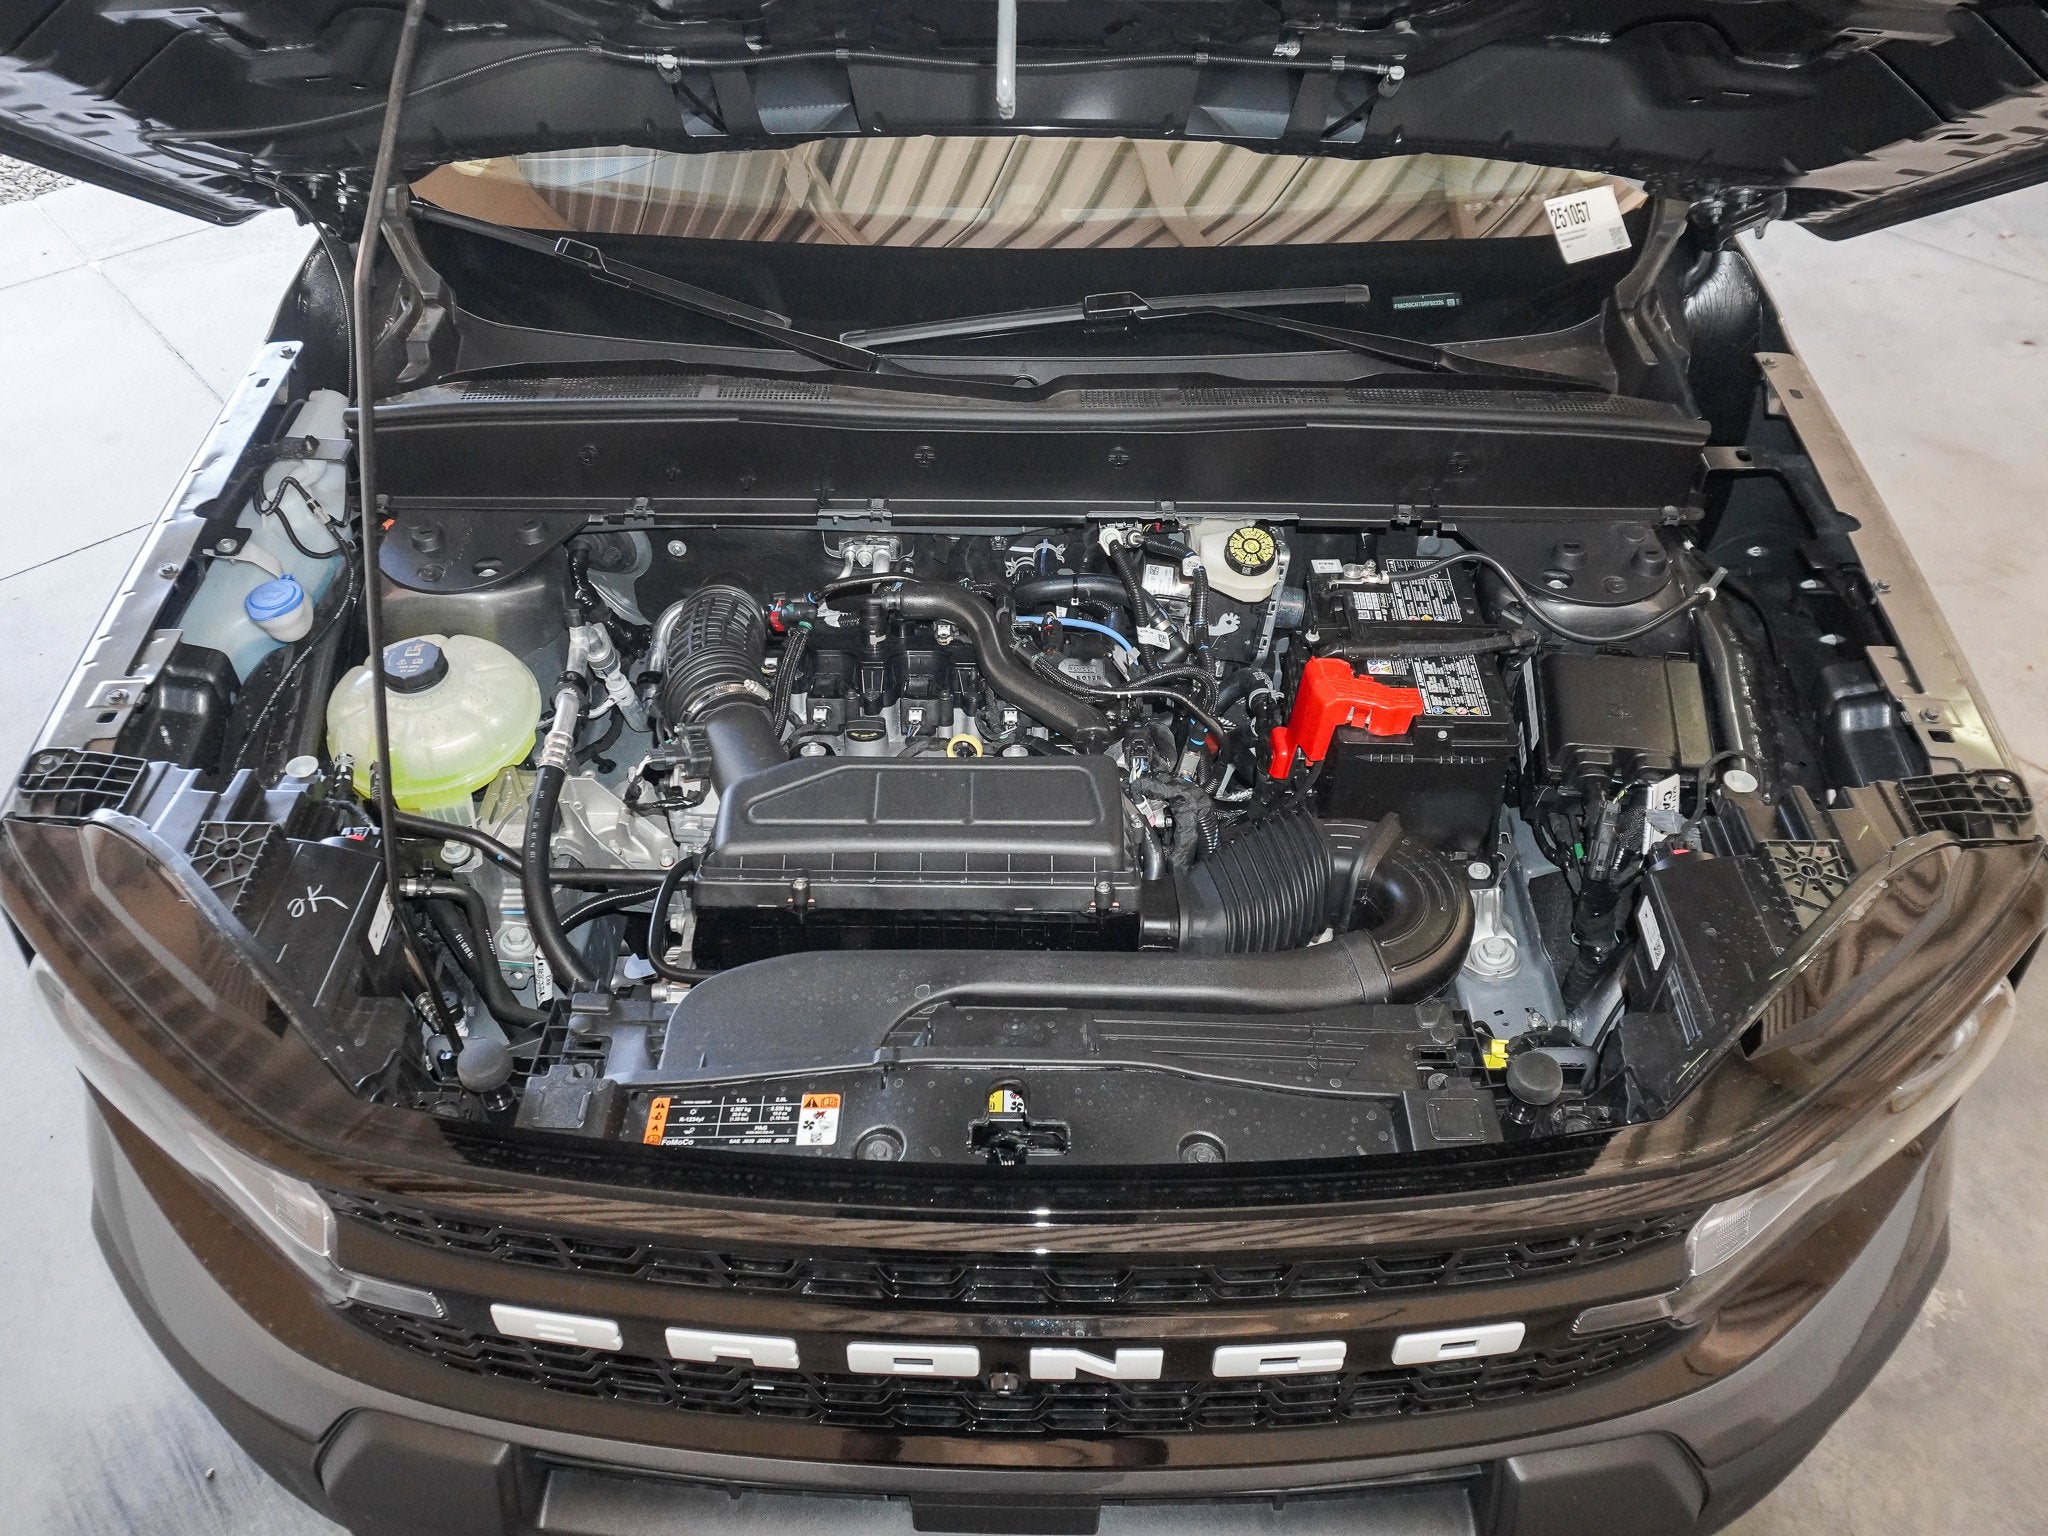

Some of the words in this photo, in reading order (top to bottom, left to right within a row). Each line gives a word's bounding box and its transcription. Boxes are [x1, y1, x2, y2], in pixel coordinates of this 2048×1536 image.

[1551, 201, 1591, 229] 251057
[661, 1138, 695, 1146] FoMoCo
[490, 1303, 1526, 1380] BRONCO
